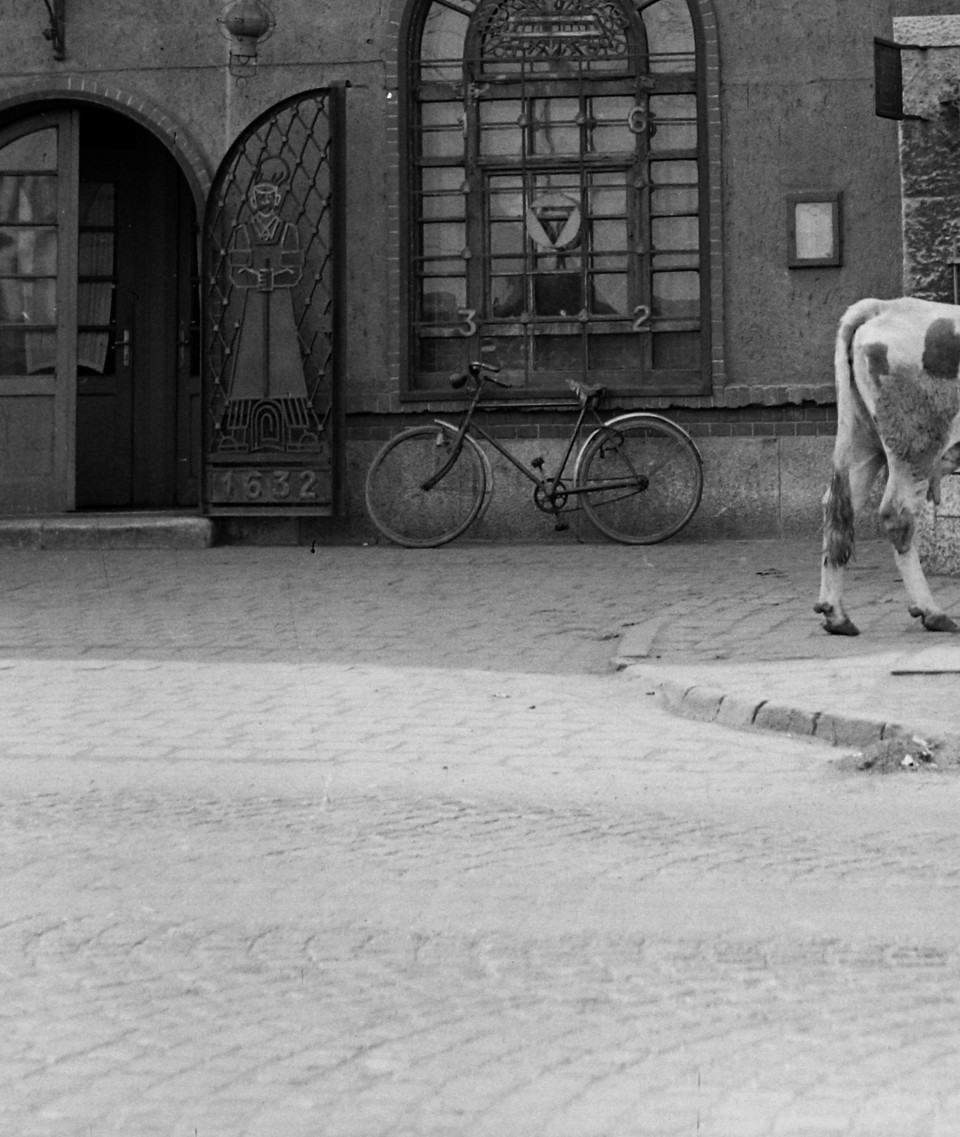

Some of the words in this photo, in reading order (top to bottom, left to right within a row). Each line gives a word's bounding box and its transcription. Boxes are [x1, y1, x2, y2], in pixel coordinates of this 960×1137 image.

[628, 106, 648, 134] 6
[458, 309, 477, 336] 3
[632, 305, 650, 332] 2
[223, 469, 317, 497] 1632
